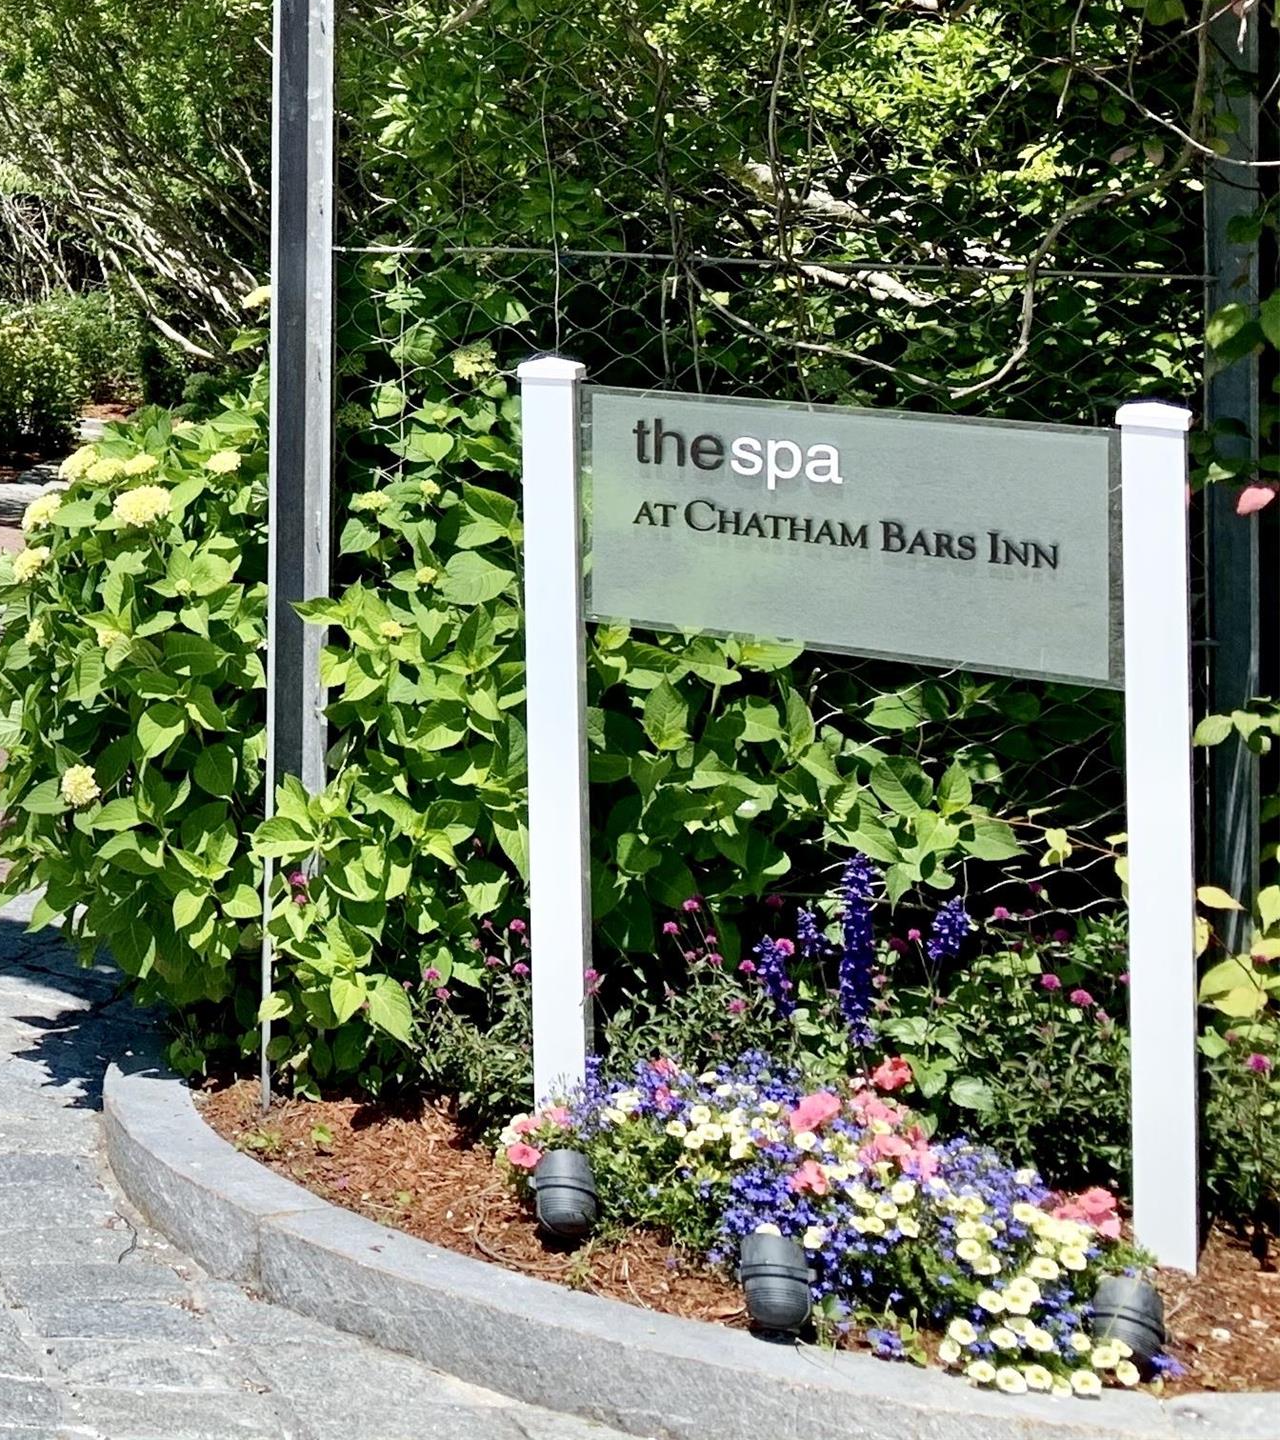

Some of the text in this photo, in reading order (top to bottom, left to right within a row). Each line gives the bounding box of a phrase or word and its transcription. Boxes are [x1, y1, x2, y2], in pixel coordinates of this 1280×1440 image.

[631, 498, 1060, 571] AT CHATHAM BARS INN
